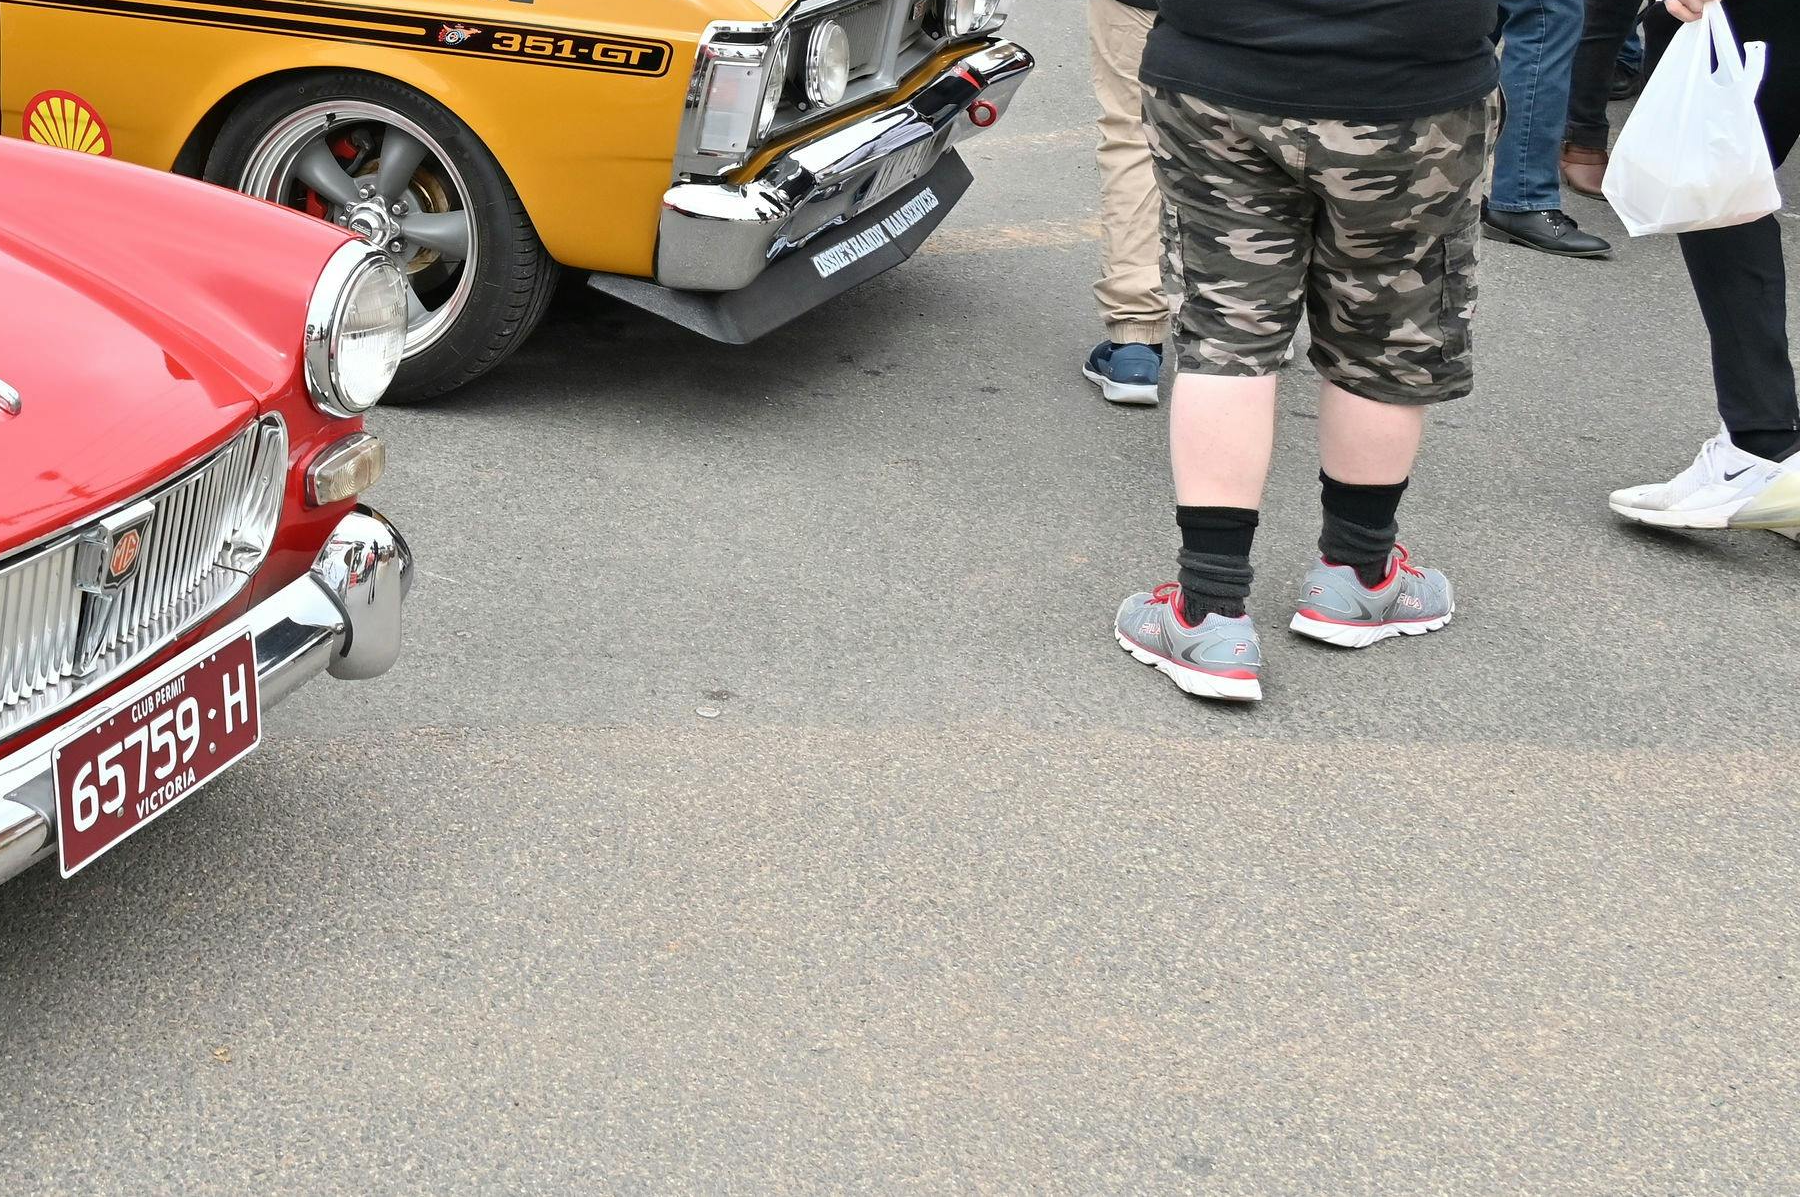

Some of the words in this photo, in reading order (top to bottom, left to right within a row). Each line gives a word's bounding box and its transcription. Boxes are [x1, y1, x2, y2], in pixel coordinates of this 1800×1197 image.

[491, 31, 653, 65] 351-GT
[812, 237, 859, 279] OSSIE'S
[849, 223, 891, 258] HANDY
[881, 209, 911, 239] MAN
[901, 186, 940, 228] SERVICES
[113, 534, 136, 571] MG
[1397, 592, 1423, 610] FILA
[1139, 622, 1161, 635] FILA
[131, 697, 154, 723] CLUB
[155, 674, 187, 708] PERMIT
[71, 695, 201, 833] 65759
[222, 663, 249, 734] H
[135, 766, 197, 820] VICTORIA
